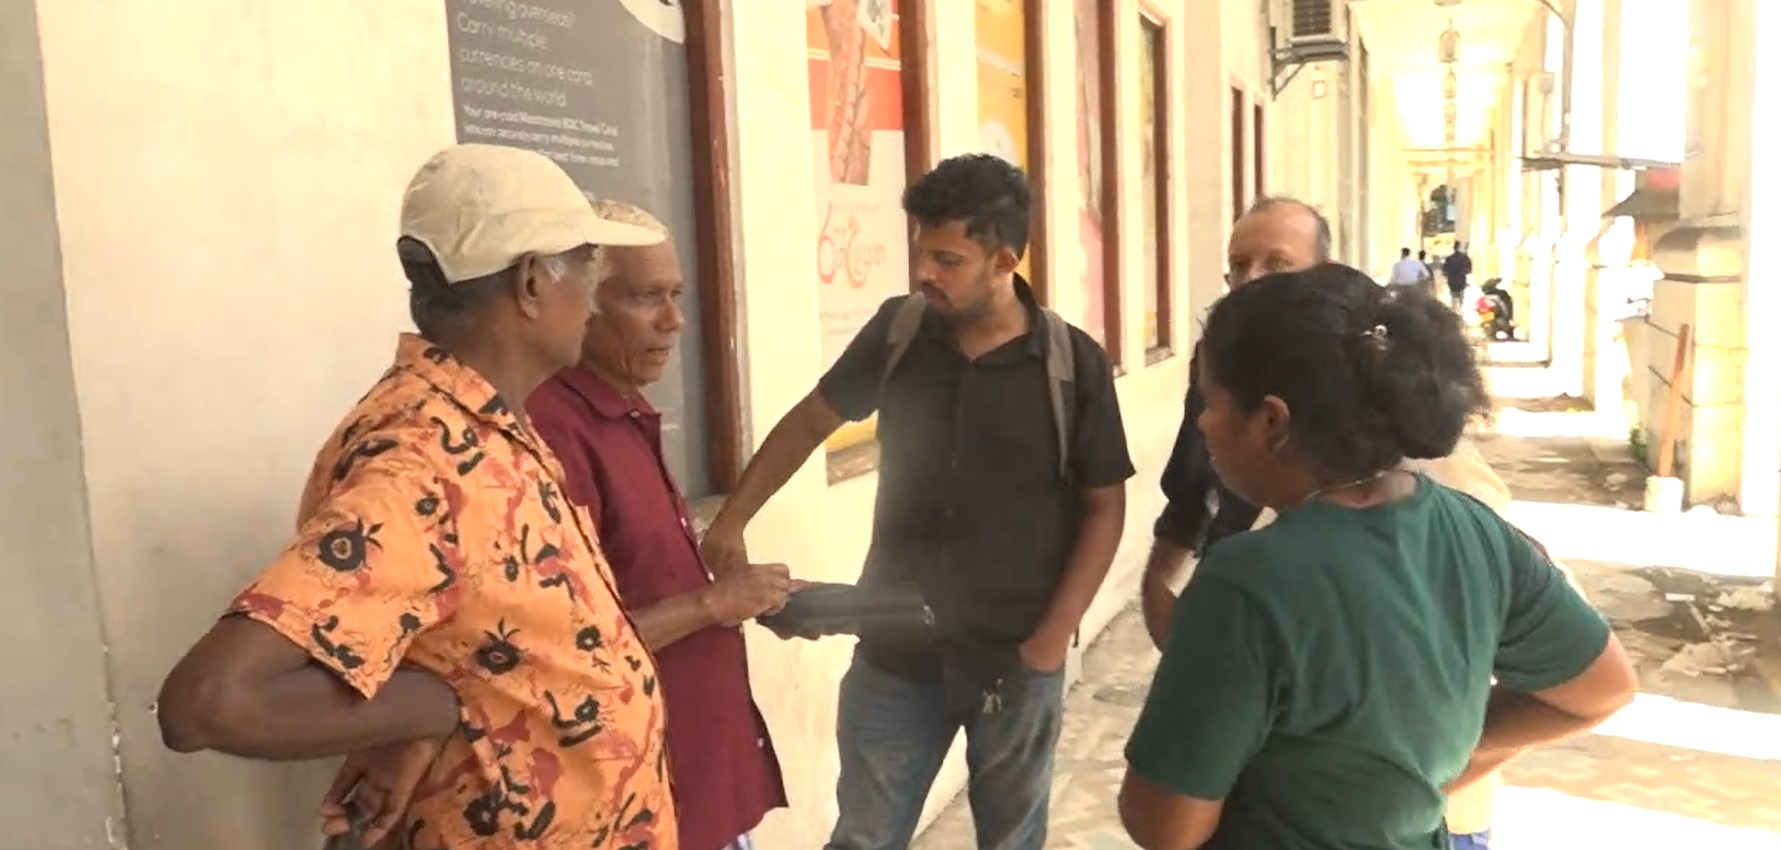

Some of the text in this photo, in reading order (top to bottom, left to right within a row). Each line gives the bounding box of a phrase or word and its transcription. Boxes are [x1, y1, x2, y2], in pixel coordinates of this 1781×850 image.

[457, 11, 548, 51] Carry multiple
[460, 48, 593, 86] currencies on one card
[461, 76, 567, 107] around the world
